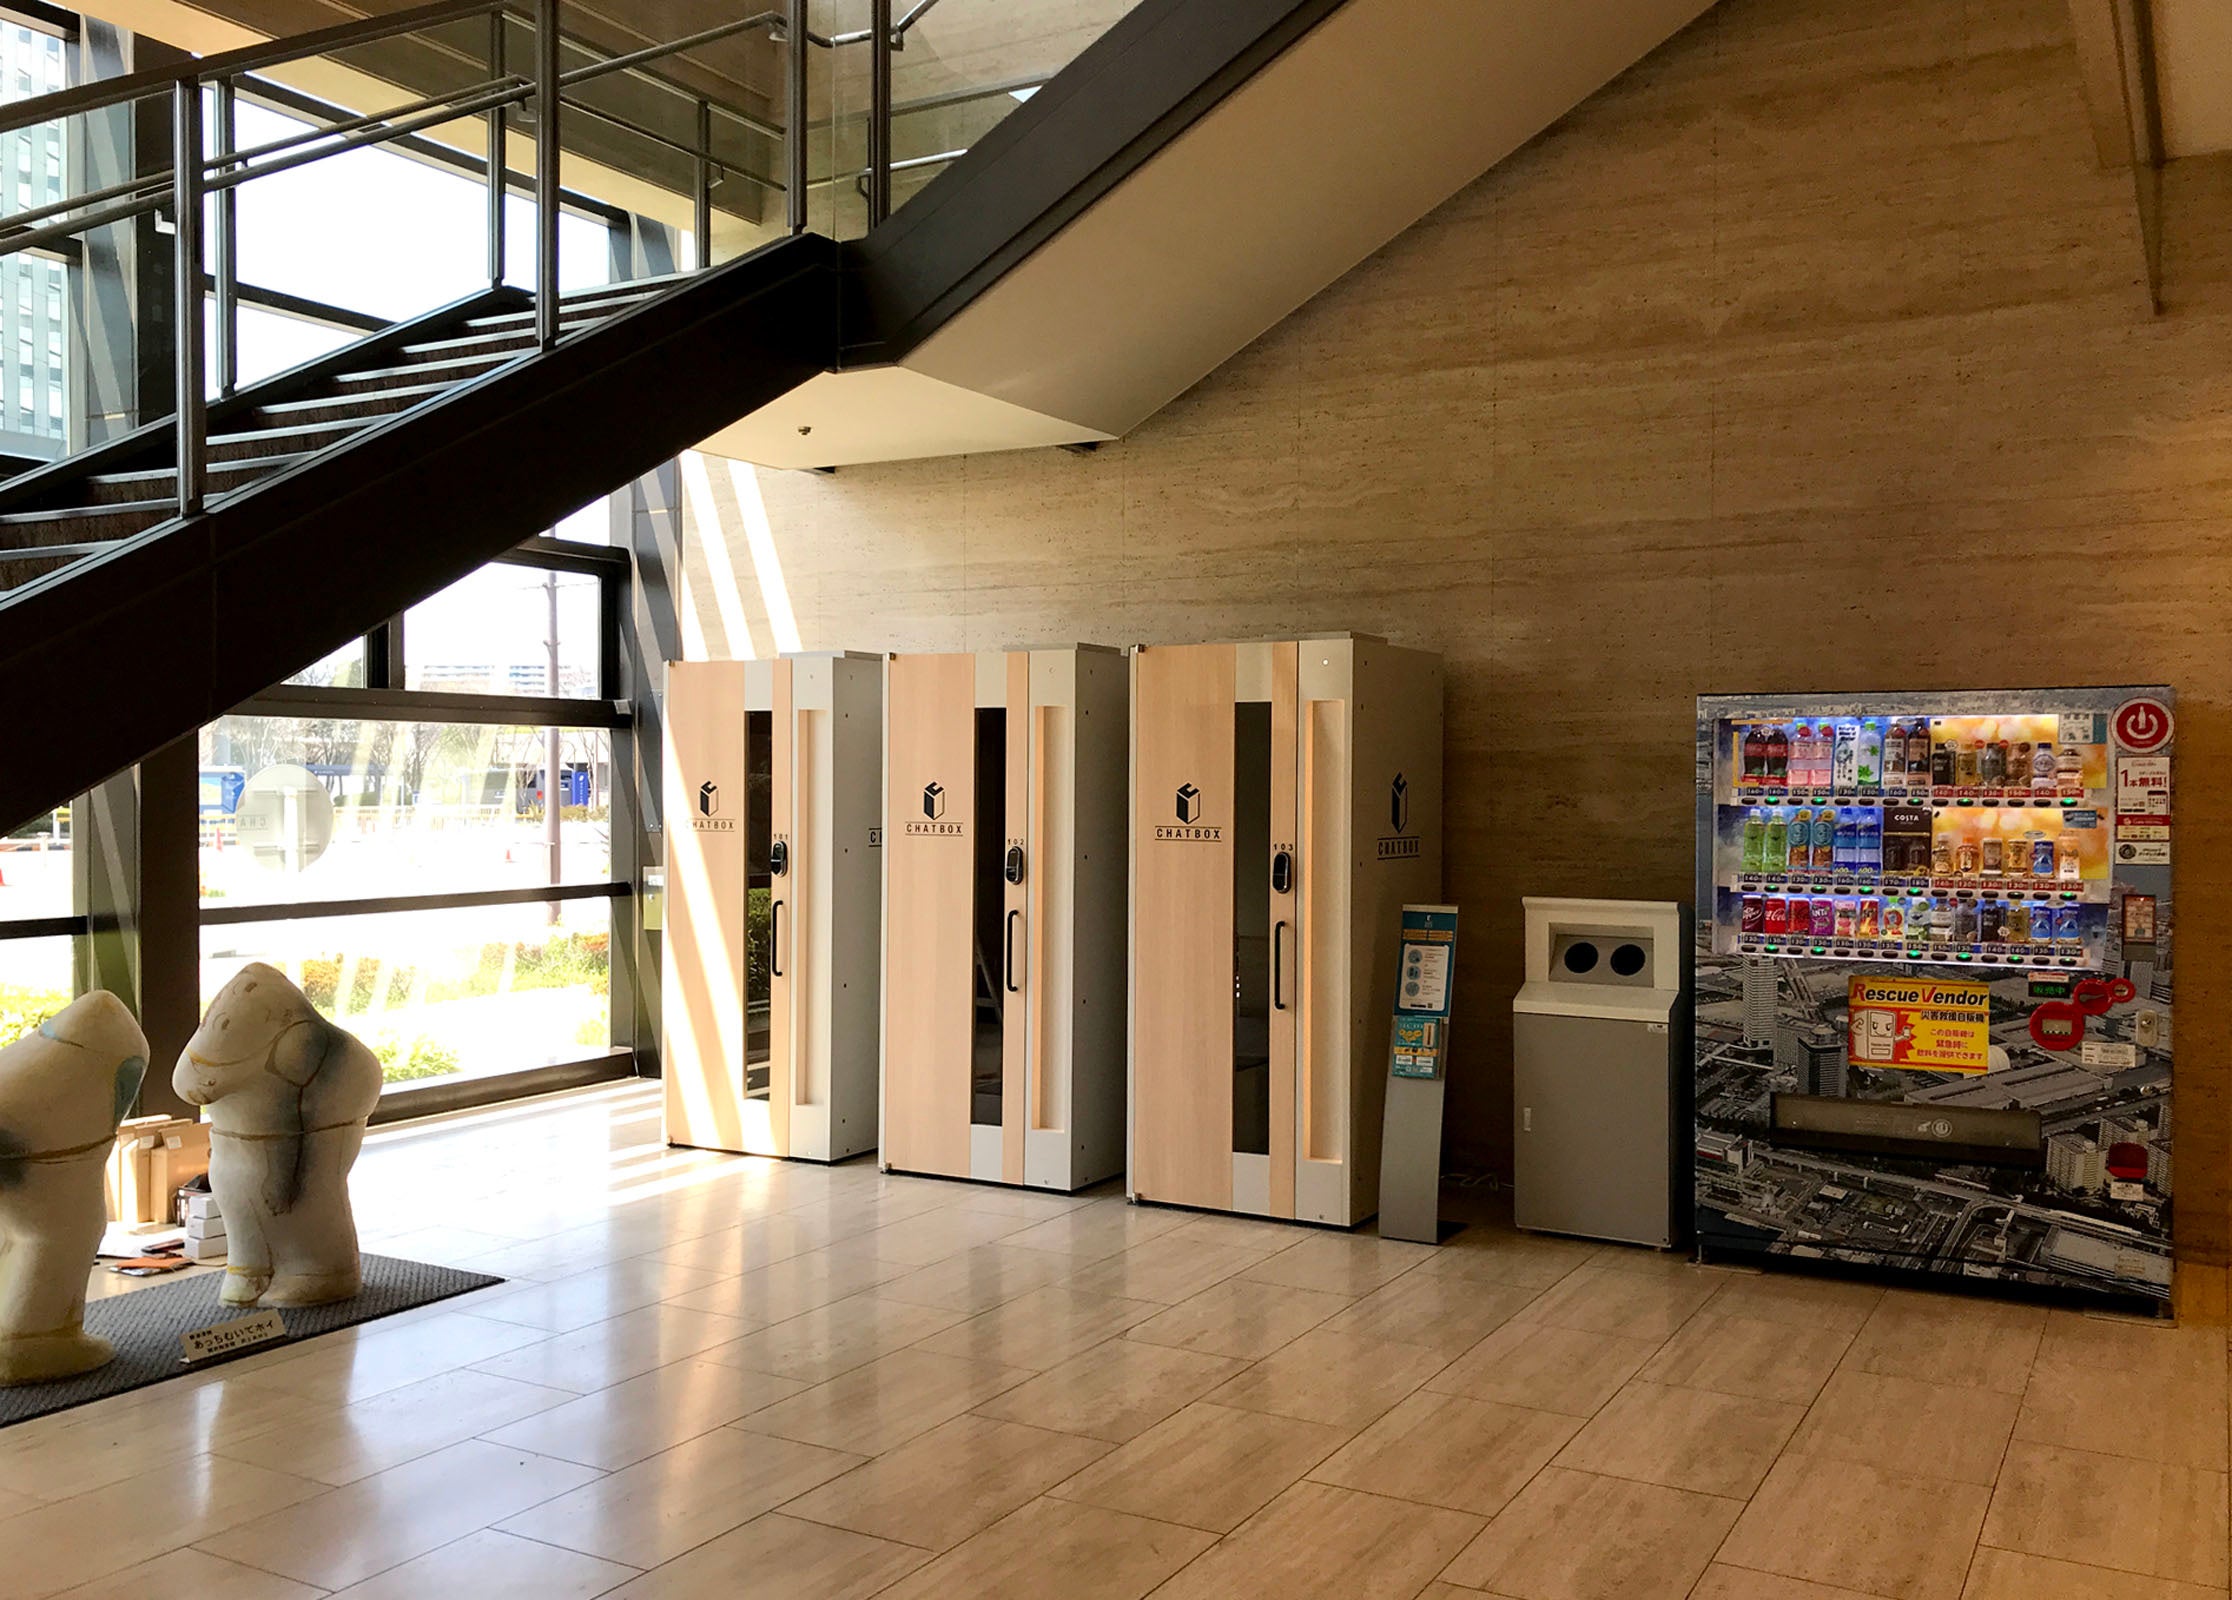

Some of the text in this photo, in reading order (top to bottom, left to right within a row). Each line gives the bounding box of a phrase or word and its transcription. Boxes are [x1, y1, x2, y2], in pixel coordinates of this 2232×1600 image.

[685, 820, 734, 830] HATBOX
[906, 824, 962, 834] CHATBOX
[1156, 828, 1220, 839] CHATBOX
[1273, 843, 1294, 851] 103
[1378, 840, 1419, 856] CHATBOX
[1851, 982, 1988, 1006] Rescue Vendor
[194, 1319, 273, 1350] あっちむいてホイ
